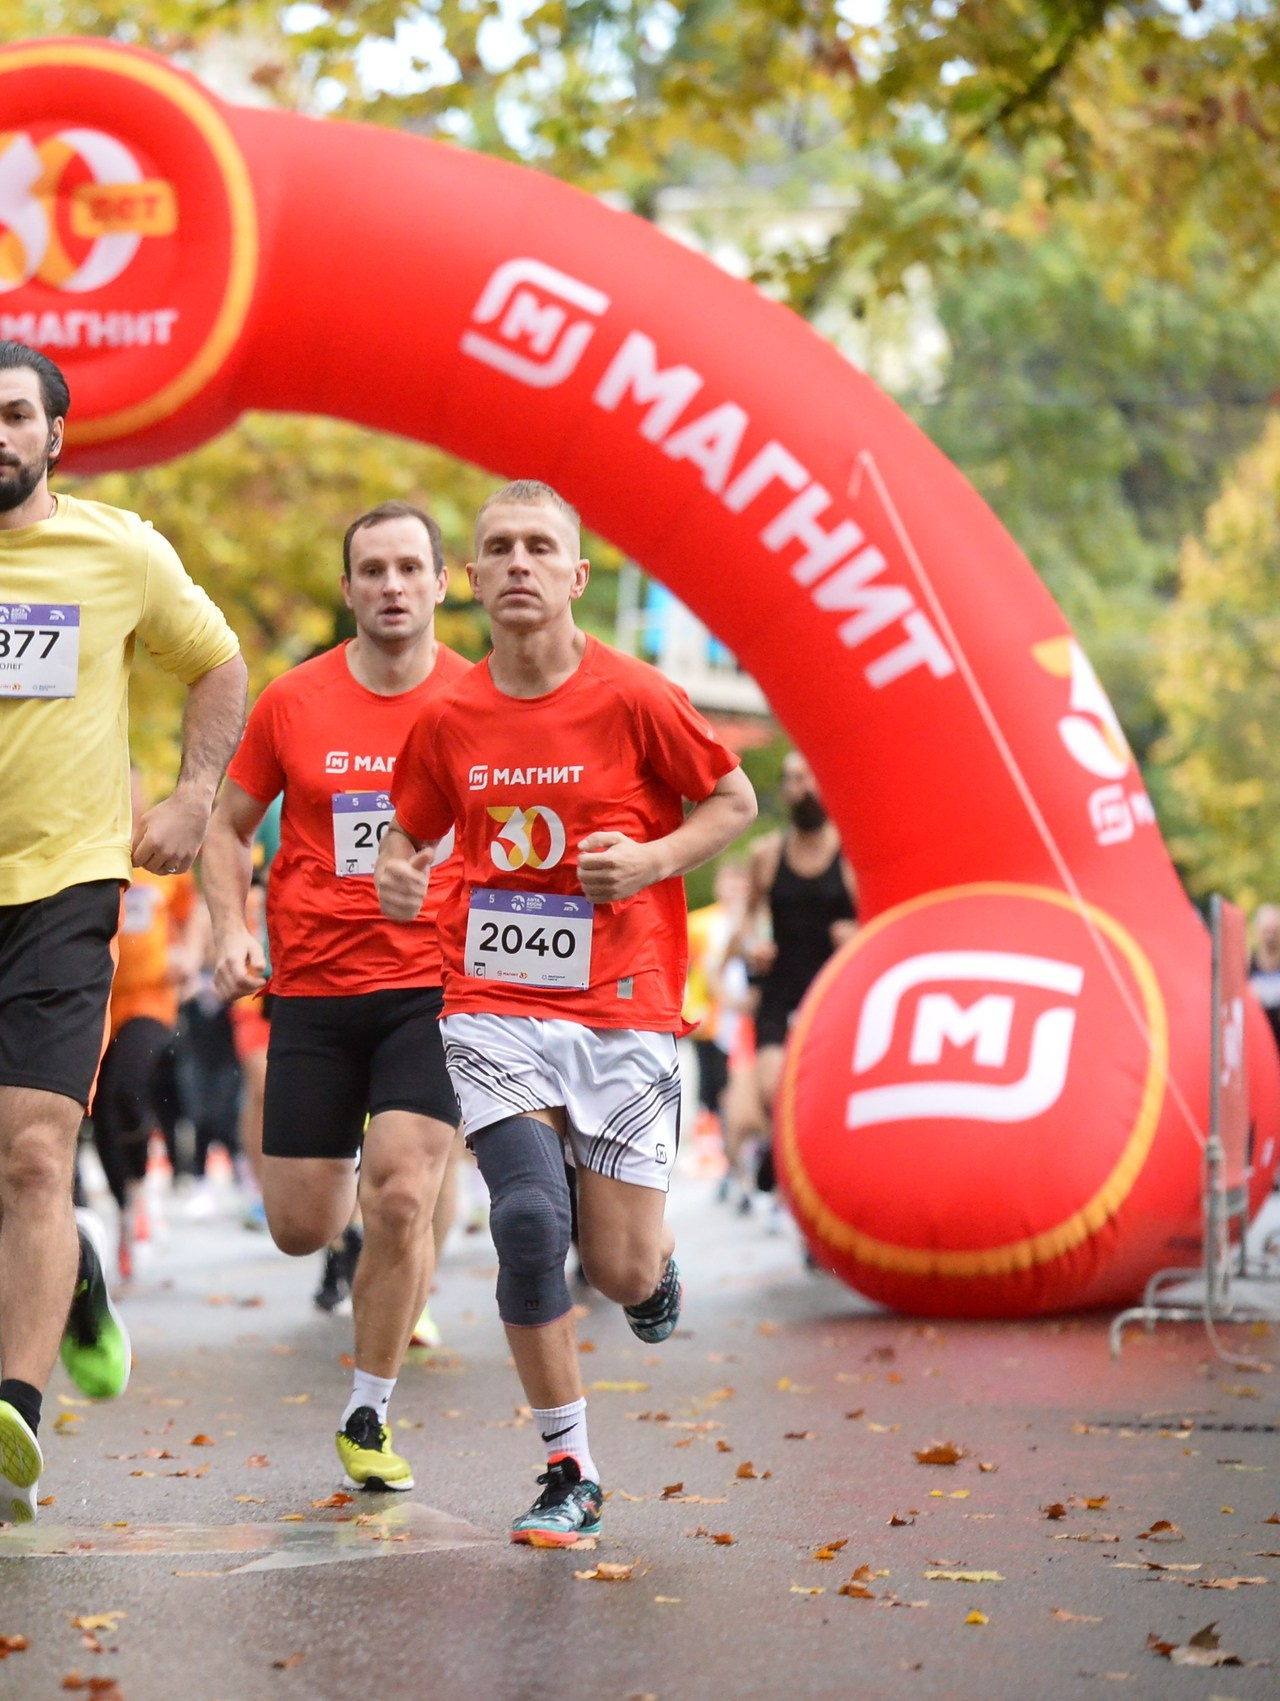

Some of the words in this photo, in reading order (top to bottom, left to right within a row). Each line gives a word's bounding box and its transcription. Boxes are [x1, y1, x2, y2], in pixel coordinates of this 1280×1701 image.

[592, 331, 956, 691] МАГНИТ
[0, 662, 23, 671] ОЛЕГ
[493, 765, 584, 786] МАГНИТ
[352, 798, 359, 806] 5
[486, 805, 566, 872] 30
[488, 894, 495, 904] 5
[479, 922, 576, 959] 2040
